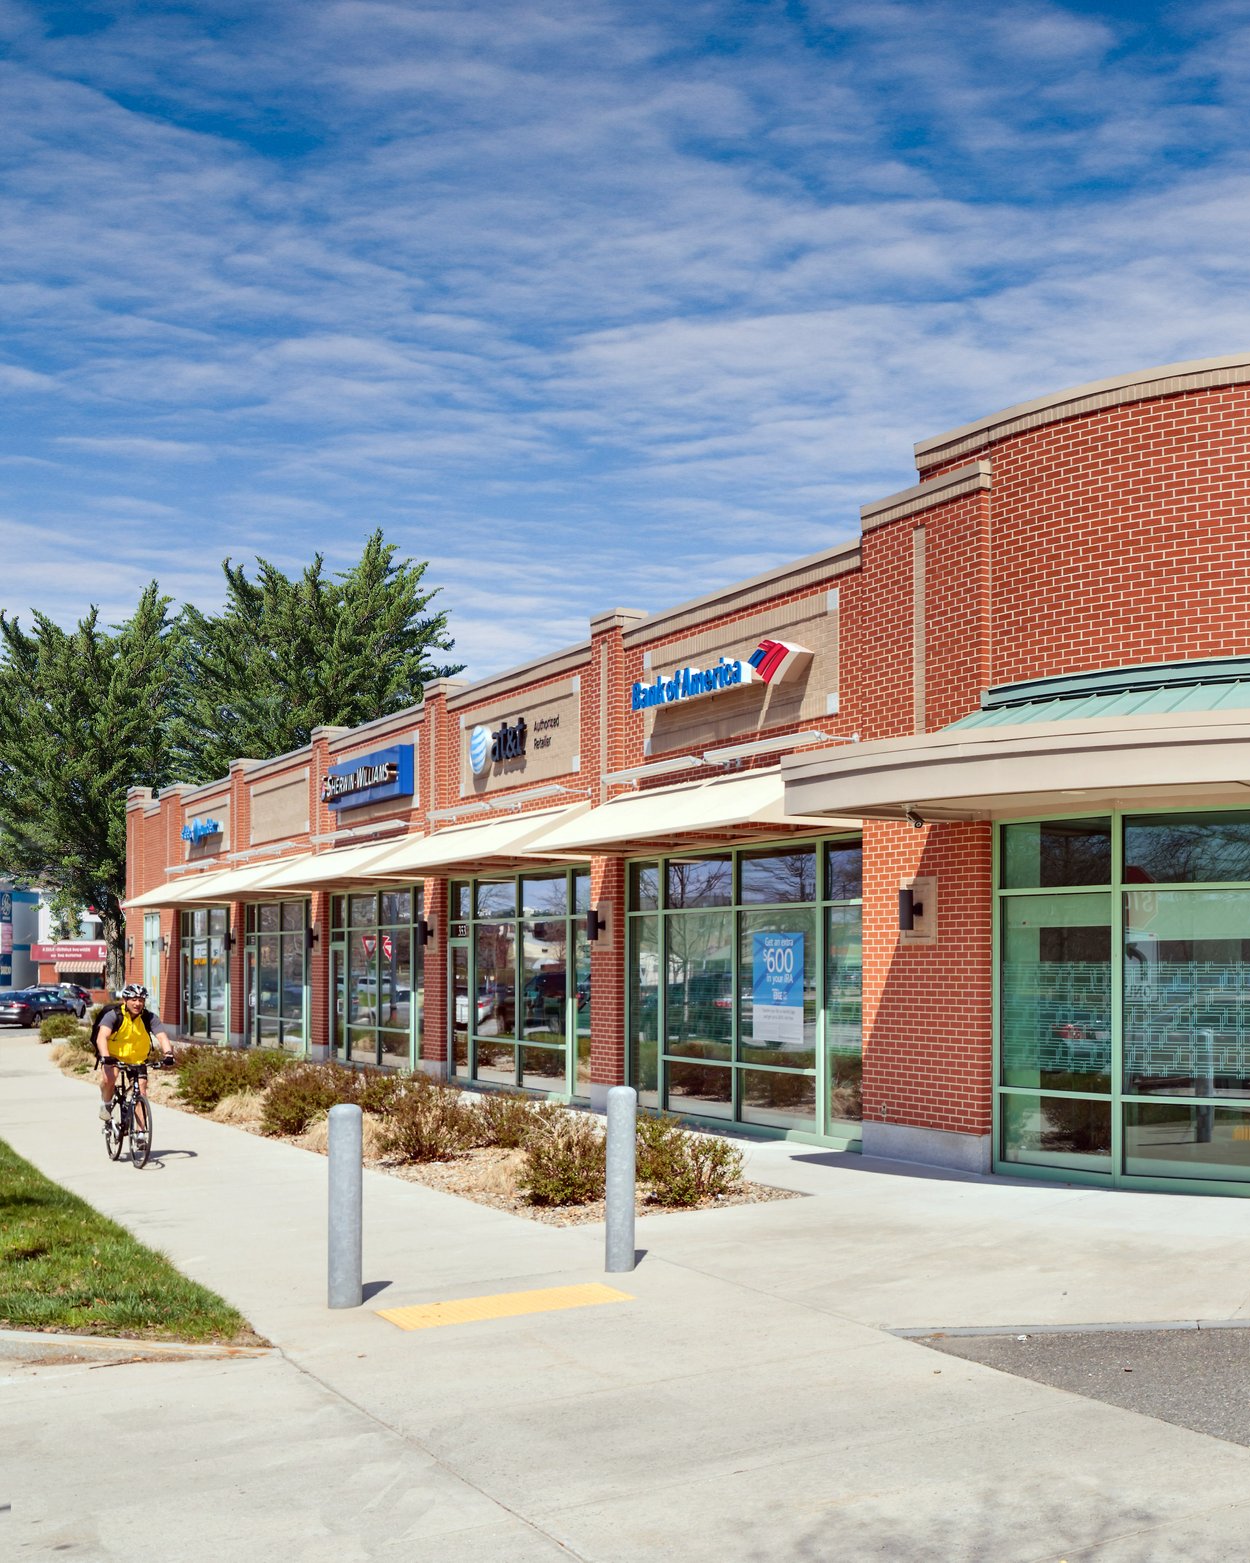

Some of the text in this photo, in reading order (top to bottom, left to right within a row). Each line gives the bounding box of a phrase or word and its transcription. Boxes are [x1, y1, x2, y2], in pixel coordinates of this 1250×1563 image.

[632, 657, 743, 711] Bank of America
[534, 714, 560, 733] Authorized
[491, 717, 527, 762] at&t
[534, 736, 551, 750] Retailer
[765, 937, 774, 947] Get
[780, 938, 794, 947] extra
[763, 948, 794, 973] $600
[771, 975, 784, 984] your
